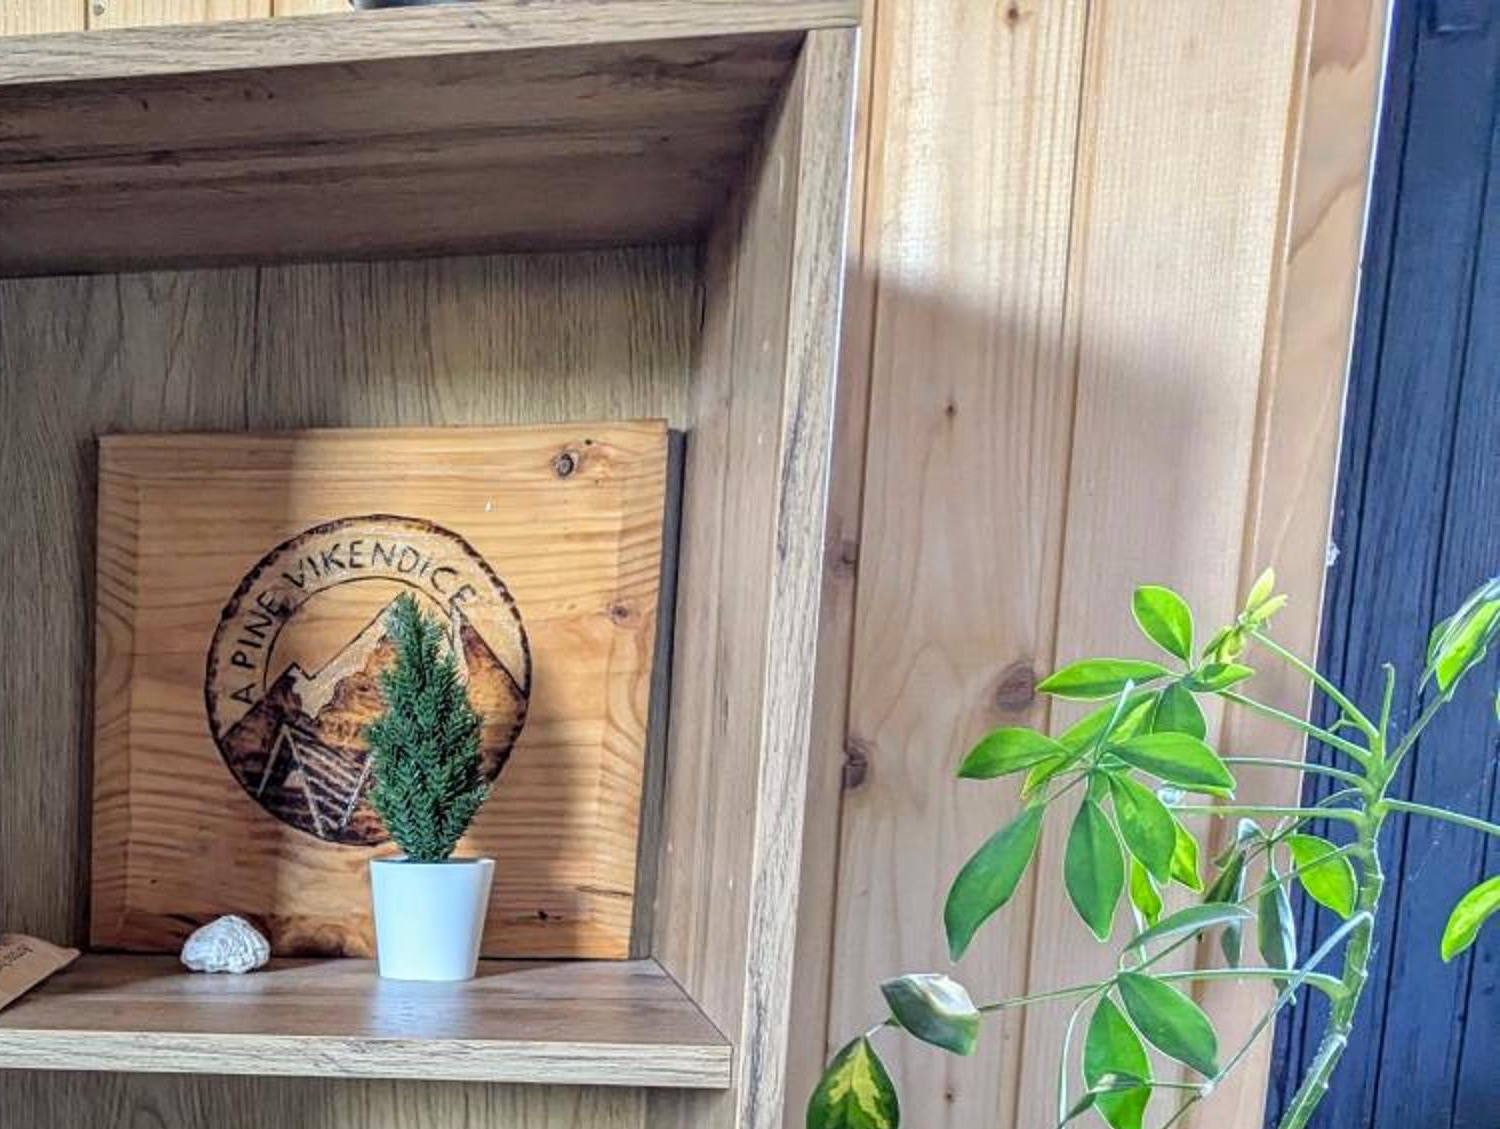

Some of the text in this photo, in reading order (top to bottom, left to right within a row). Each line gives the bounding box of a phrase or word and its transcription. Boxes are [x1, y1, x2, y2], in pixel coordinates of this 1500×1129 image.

[231, 540, 477, 705] A PINE VIKENDICE
